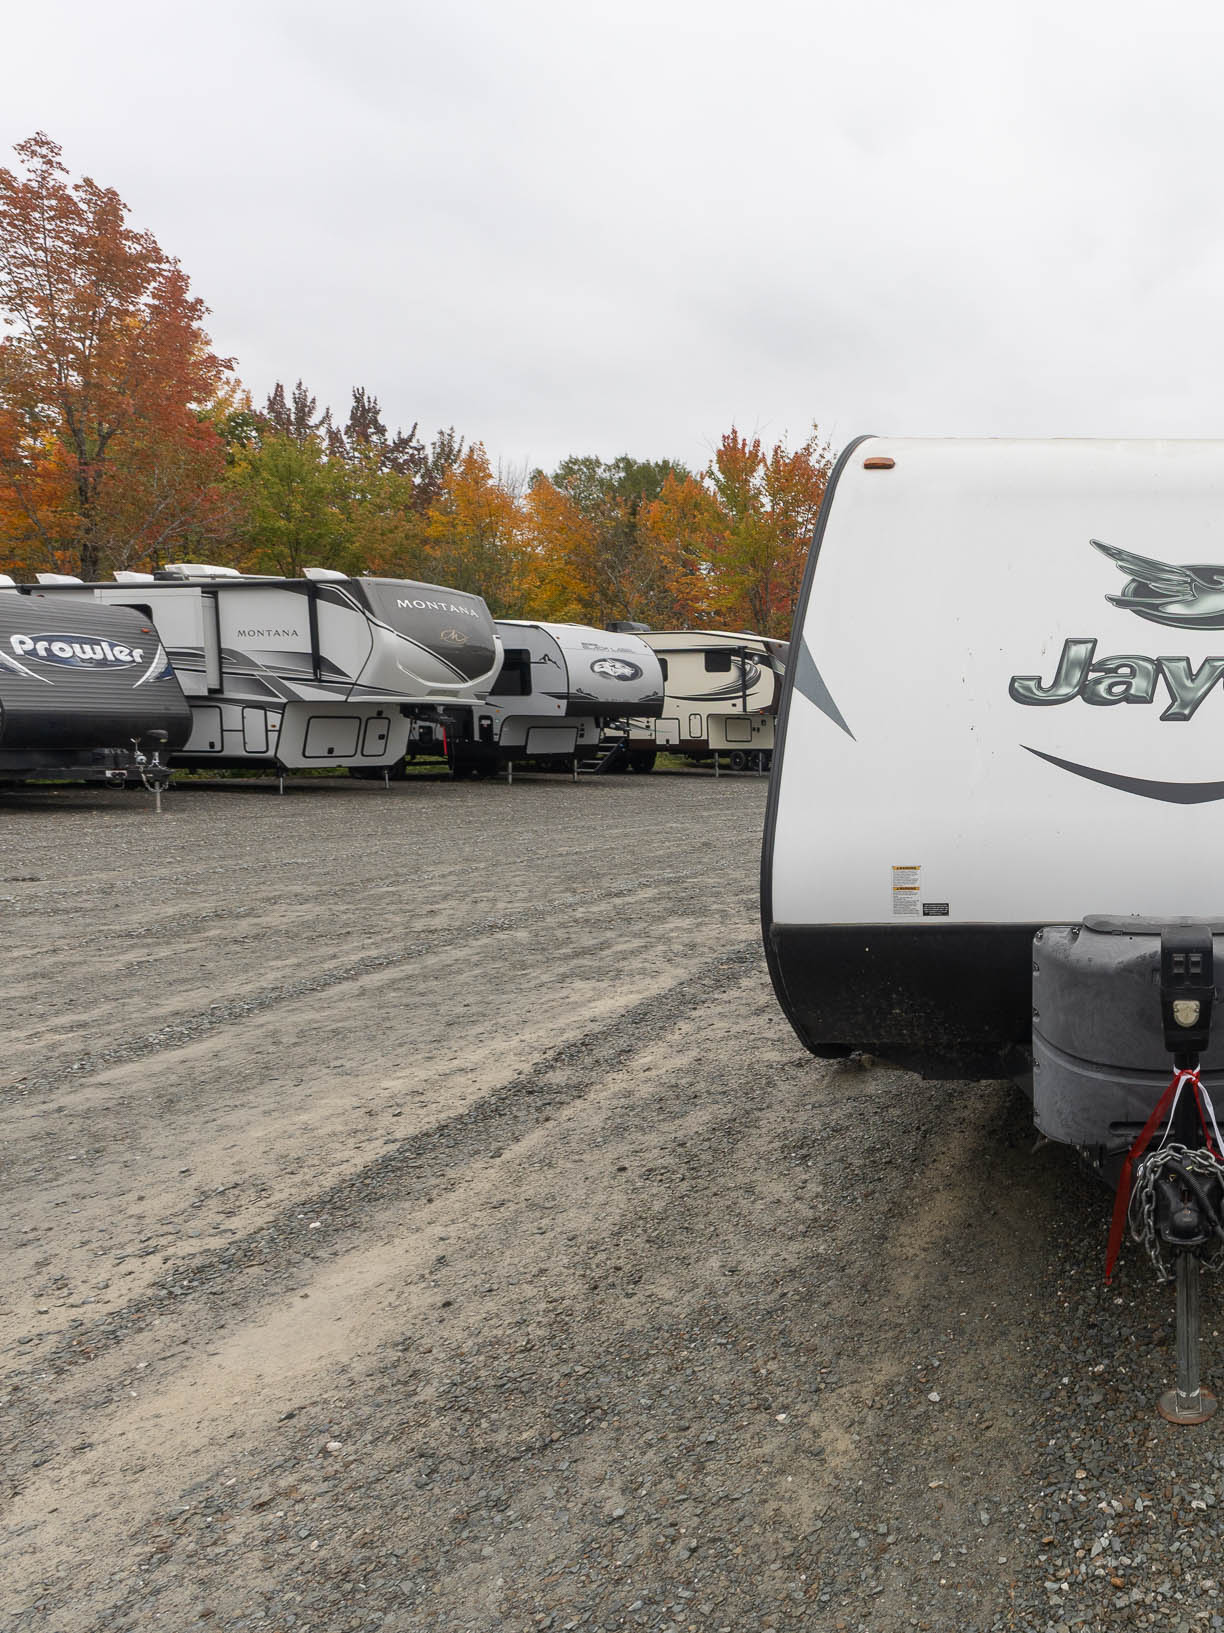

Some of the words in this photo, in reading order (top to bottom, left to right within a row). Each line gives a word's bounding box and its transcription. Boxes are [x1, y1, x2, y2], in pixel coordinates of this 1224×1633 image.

[396, 599, 480, 618] MONTANA
[237, 629, 299, 638] MONTANA
[10, 634, 145, 663] Prowler
